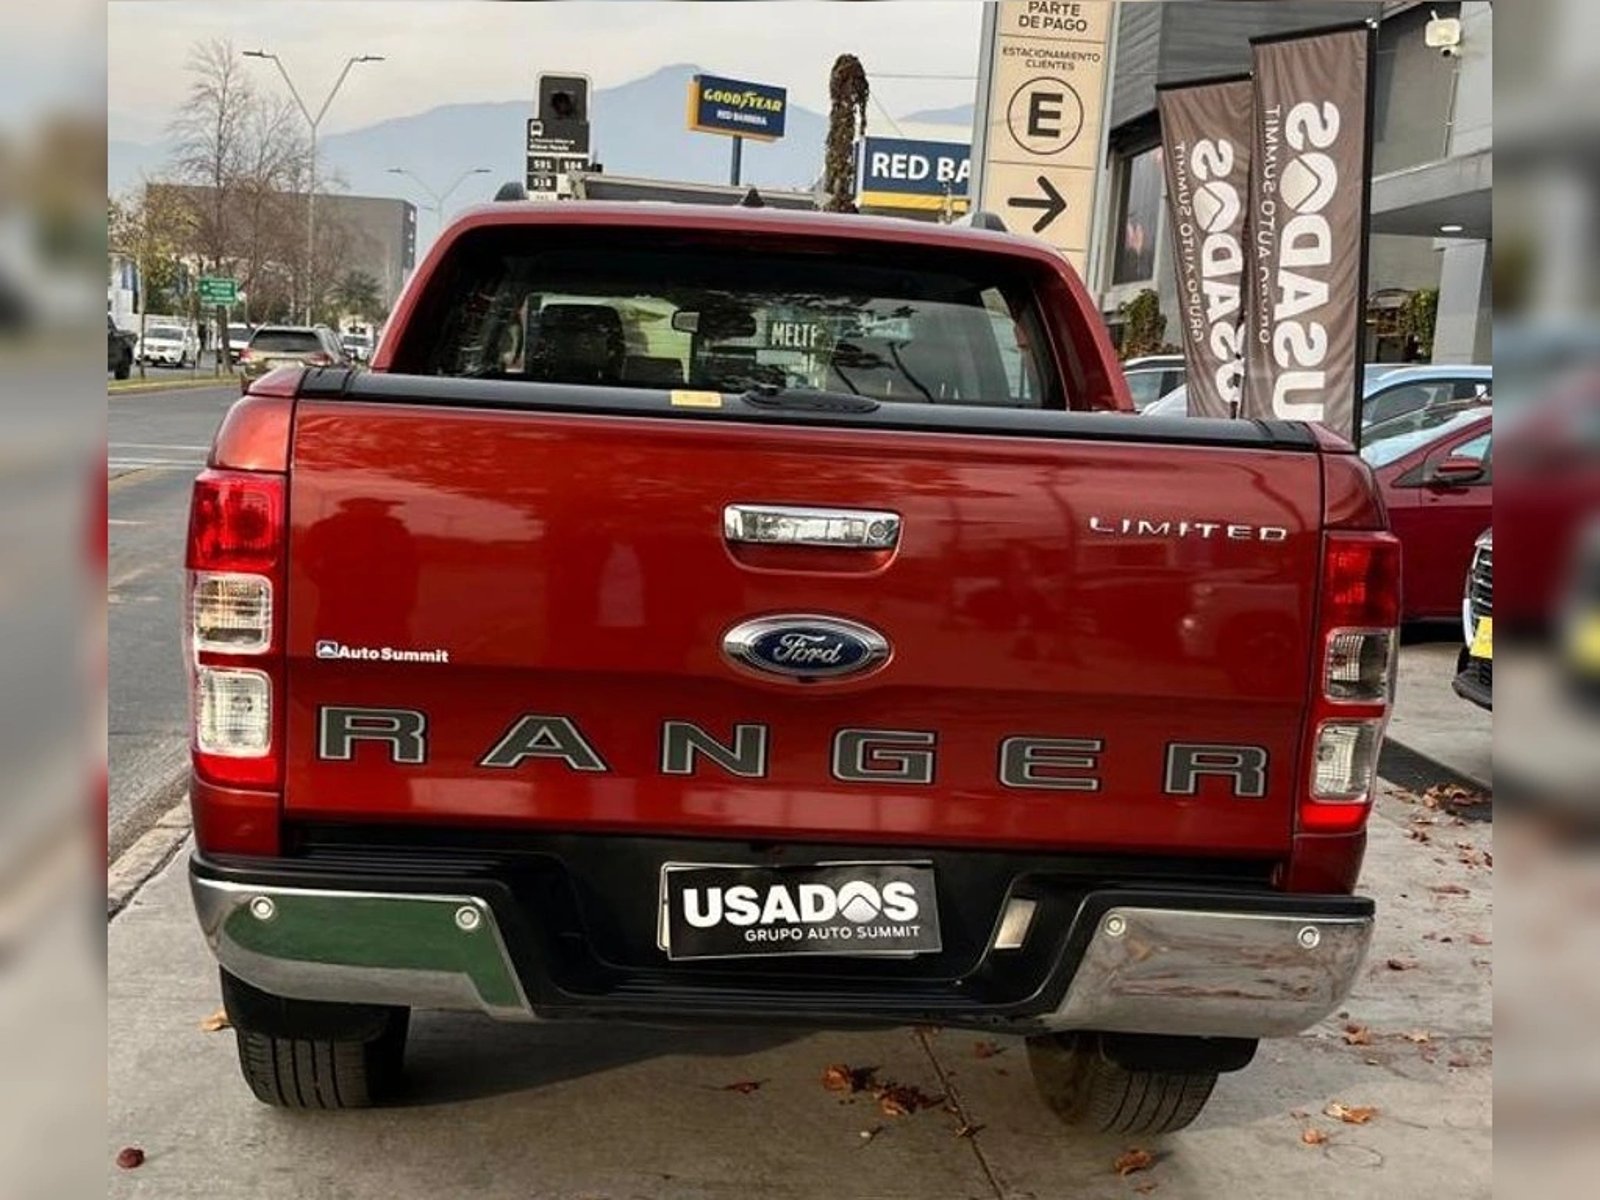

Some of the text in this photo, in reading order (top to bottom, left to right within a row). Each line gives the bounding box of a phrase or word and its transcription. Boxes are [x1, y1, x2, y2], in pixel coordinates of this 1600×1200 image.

[1028, 1, 1081, 17] PARTE
[1018, 15, 1087, 32] DE PAGO
[1003, 47, 1101, 62] ESTACIONAMIENTO
[1025, 59, 1075, 71] CLIENTES
[703, 88, 783, 112] GOODYEAR
[1028, 92, 1063, 138] E
[872, 152, 930, 181] RED
[1089, 516, 1287, 541] LIMITED
[339, 645, 450, 663] Auto Summit
[773, 633, 845, 664] Ford
[318, 704, 1269, 798] RANGER
[682, 880, 920, 928] USADOS
[744, 925, 921, 942] GRUPO AUTO SUMMIT
